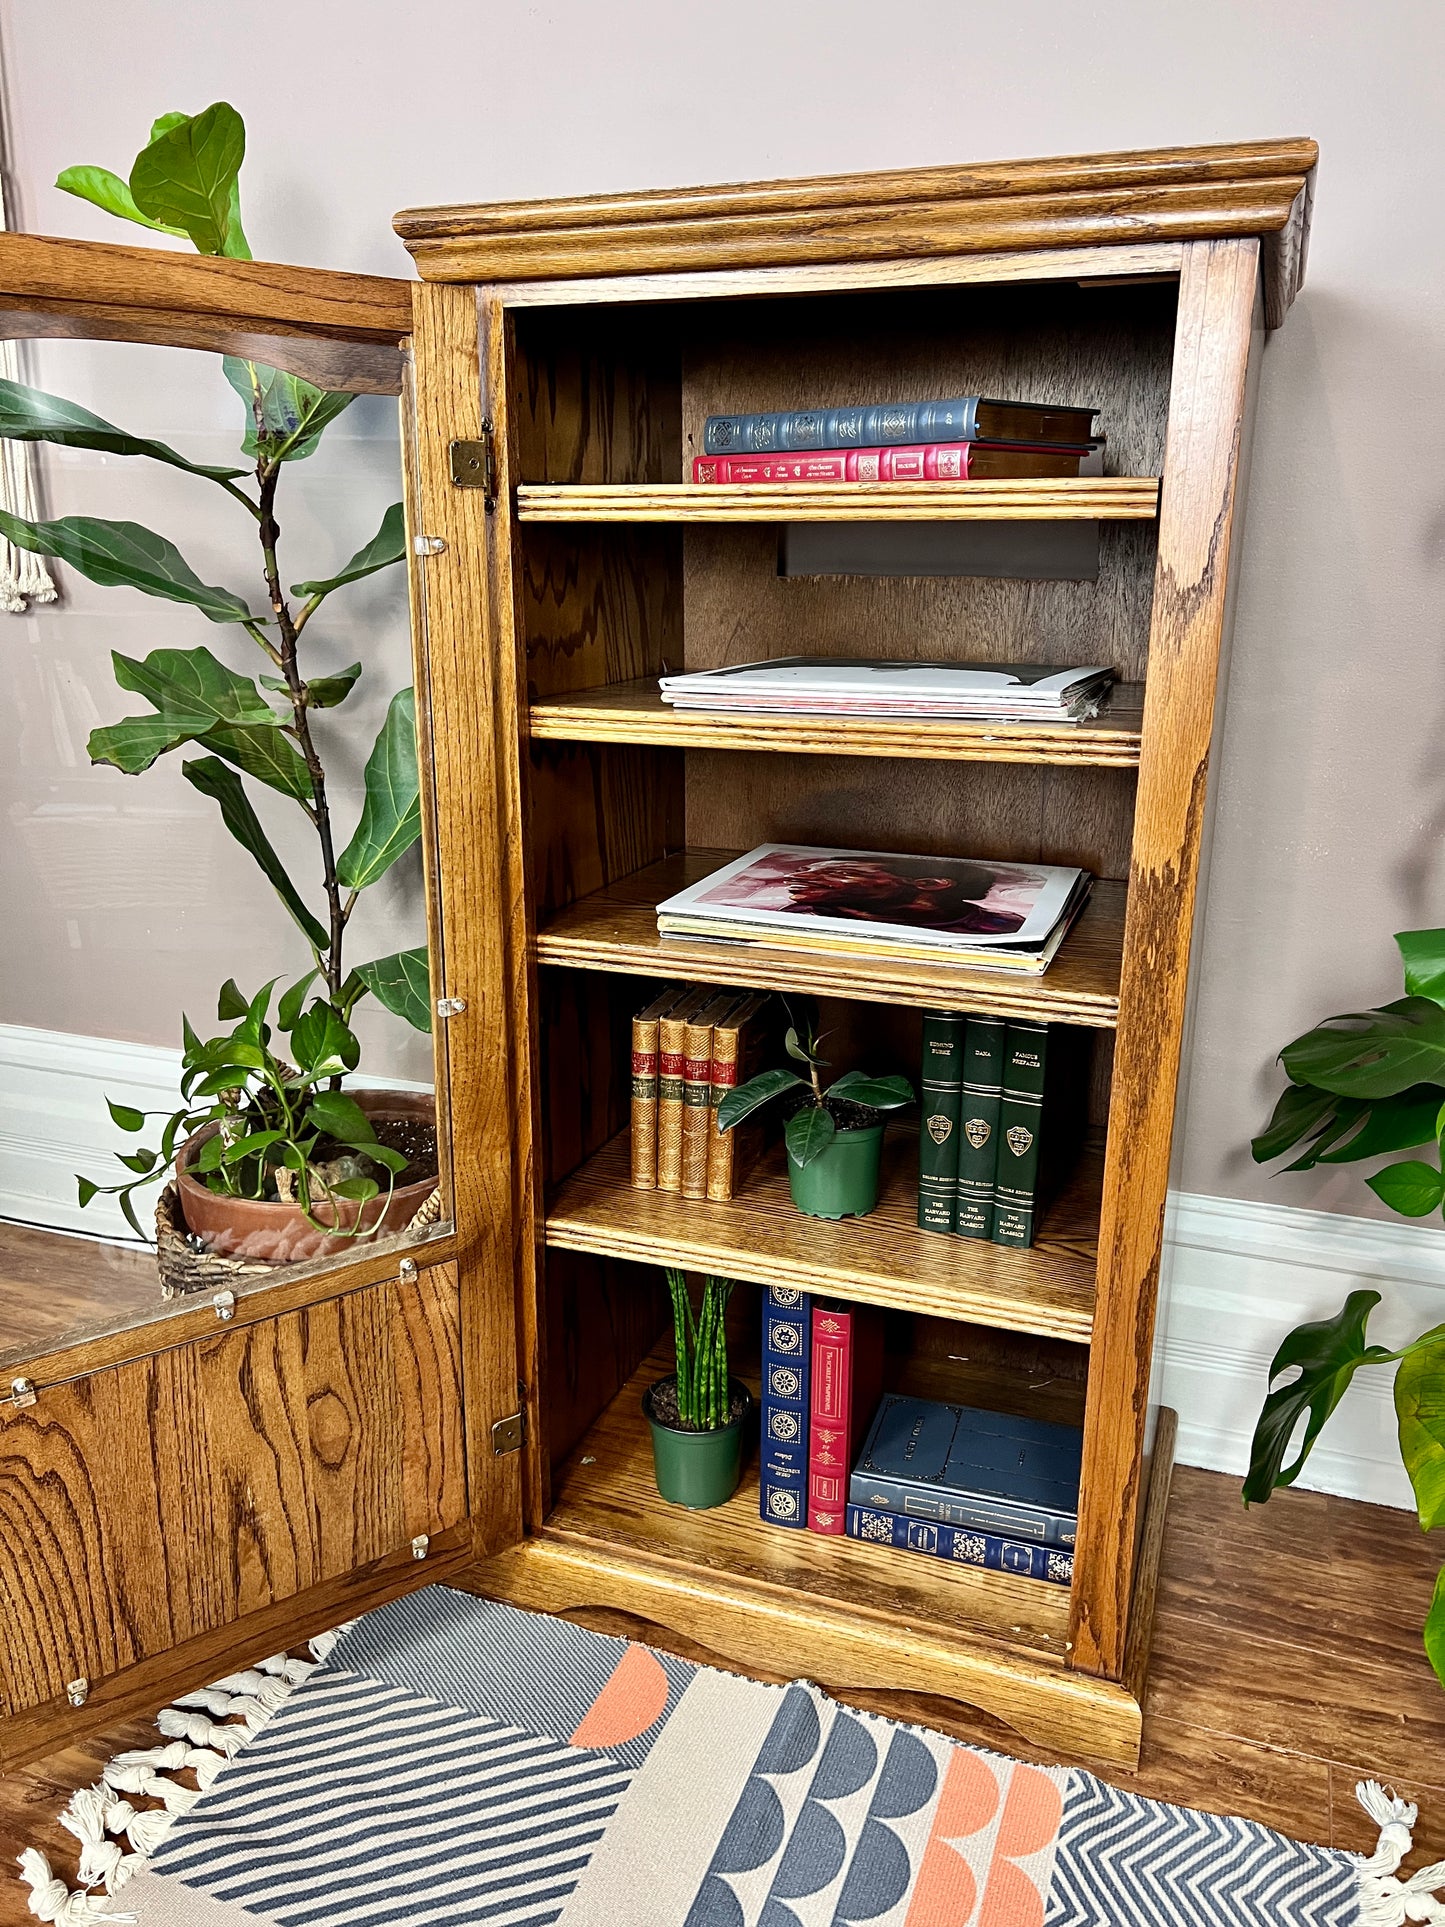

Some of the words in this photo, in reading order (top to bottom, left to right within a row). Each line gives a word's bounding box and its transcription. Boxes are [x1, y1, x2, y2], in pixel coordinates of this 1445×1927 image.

[1015, 1052, 1038, 1060] FAMOUS
[1012, 1058, 1040, 1068] PREFACES
[924, 1208, 950, 1216] HARVARD
[960, 1212, 986, 1221] HARVARD
[924, 1216, 950, 1224] CLASSICS
[960, 1220, 984, 1229] CLASSICS
[1000, 1220, 1026, 1230] HARVARD
[999, 1228, 1024, 1238] CLASSICS
